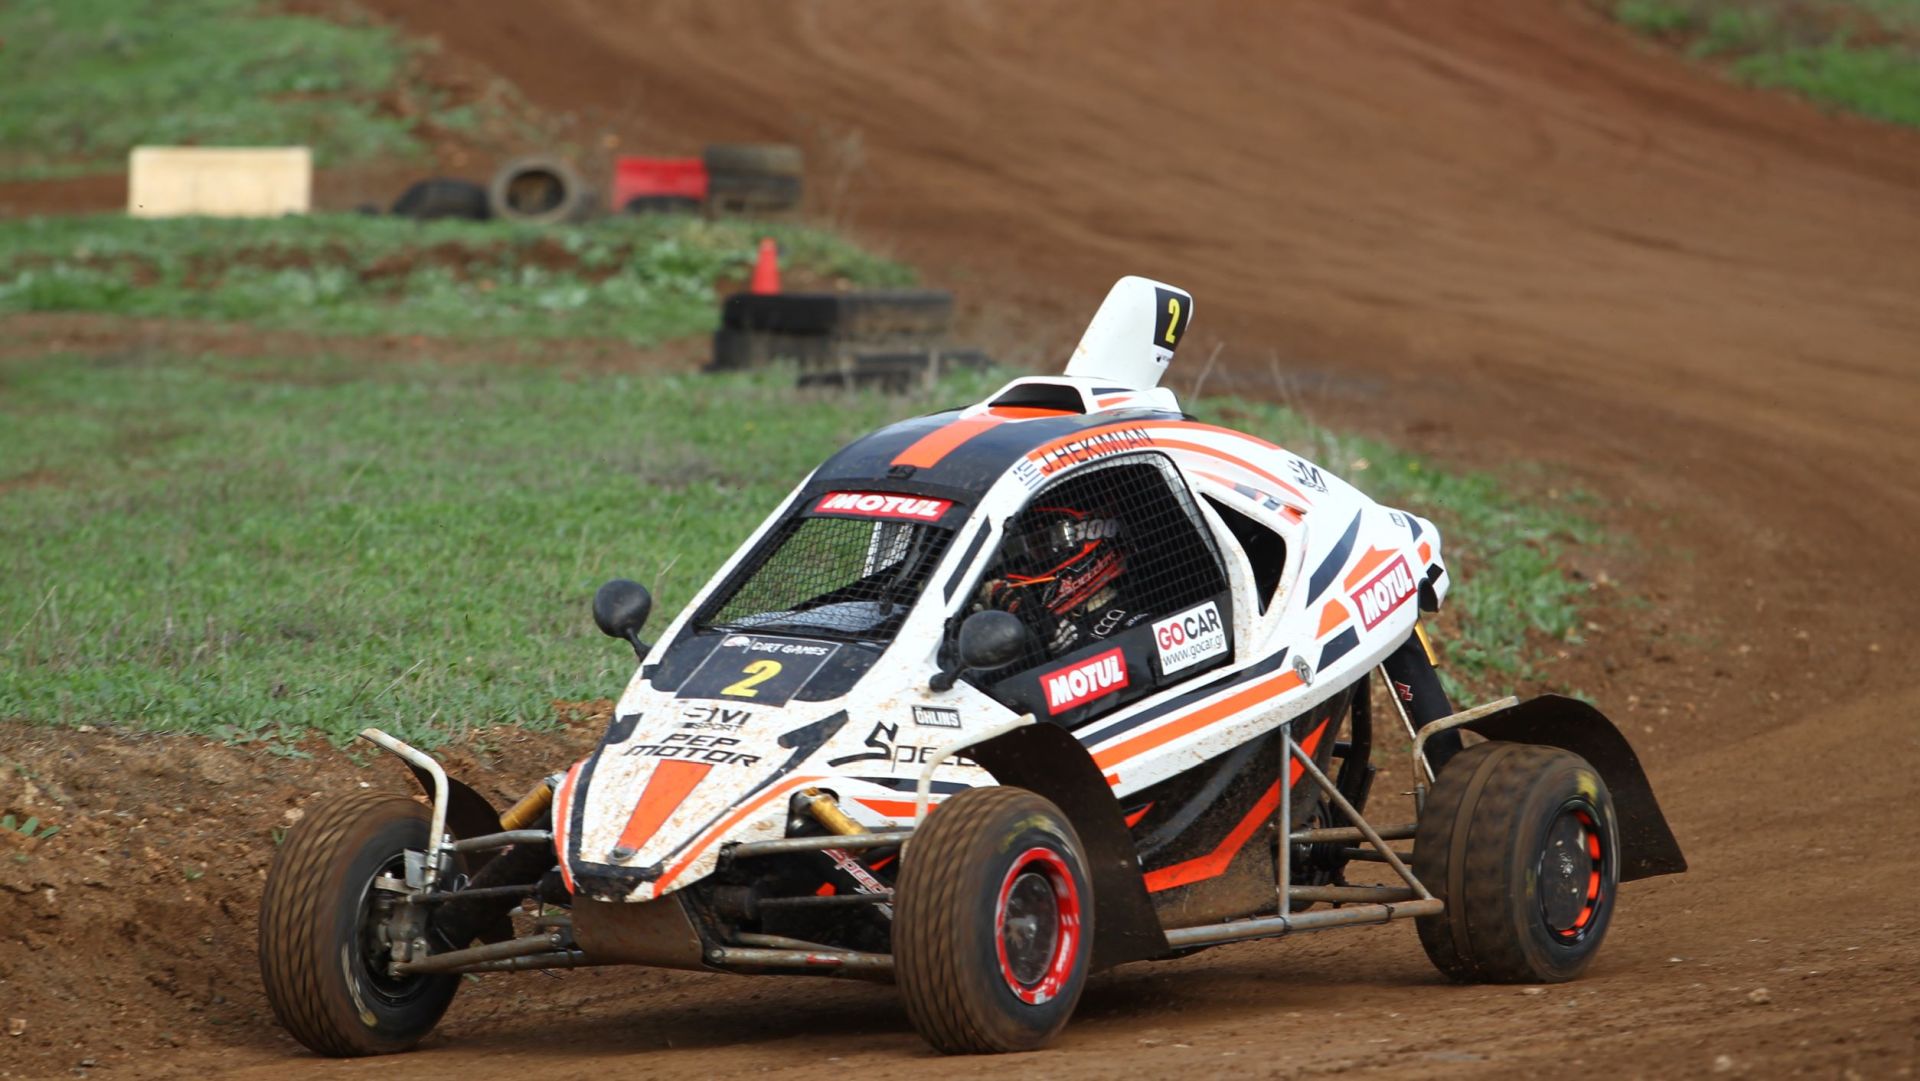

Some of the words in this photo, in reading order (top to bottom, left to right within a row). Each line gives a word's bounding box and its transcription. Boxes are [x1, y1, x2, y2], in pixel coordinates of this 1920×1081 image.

[1165, 298, 1180, 344] 2
[822, 494, 942, 517] MOTUL
[1359, 562, 1413, 625] MOTUL
[1158, 608, 1221, 651] GOCAR
[751, 642, 785, 653] DIRT
[781, 644, 829, 656] GAMES
[1163, 634, 1224, 667] www.gocar.gr
[720, 660, 783, 697] 2
[1049, 656, 1124, 707] MOTUL
[624, 745, 762, 767] MOTOR
[661, 733, 742, 748] PEP
